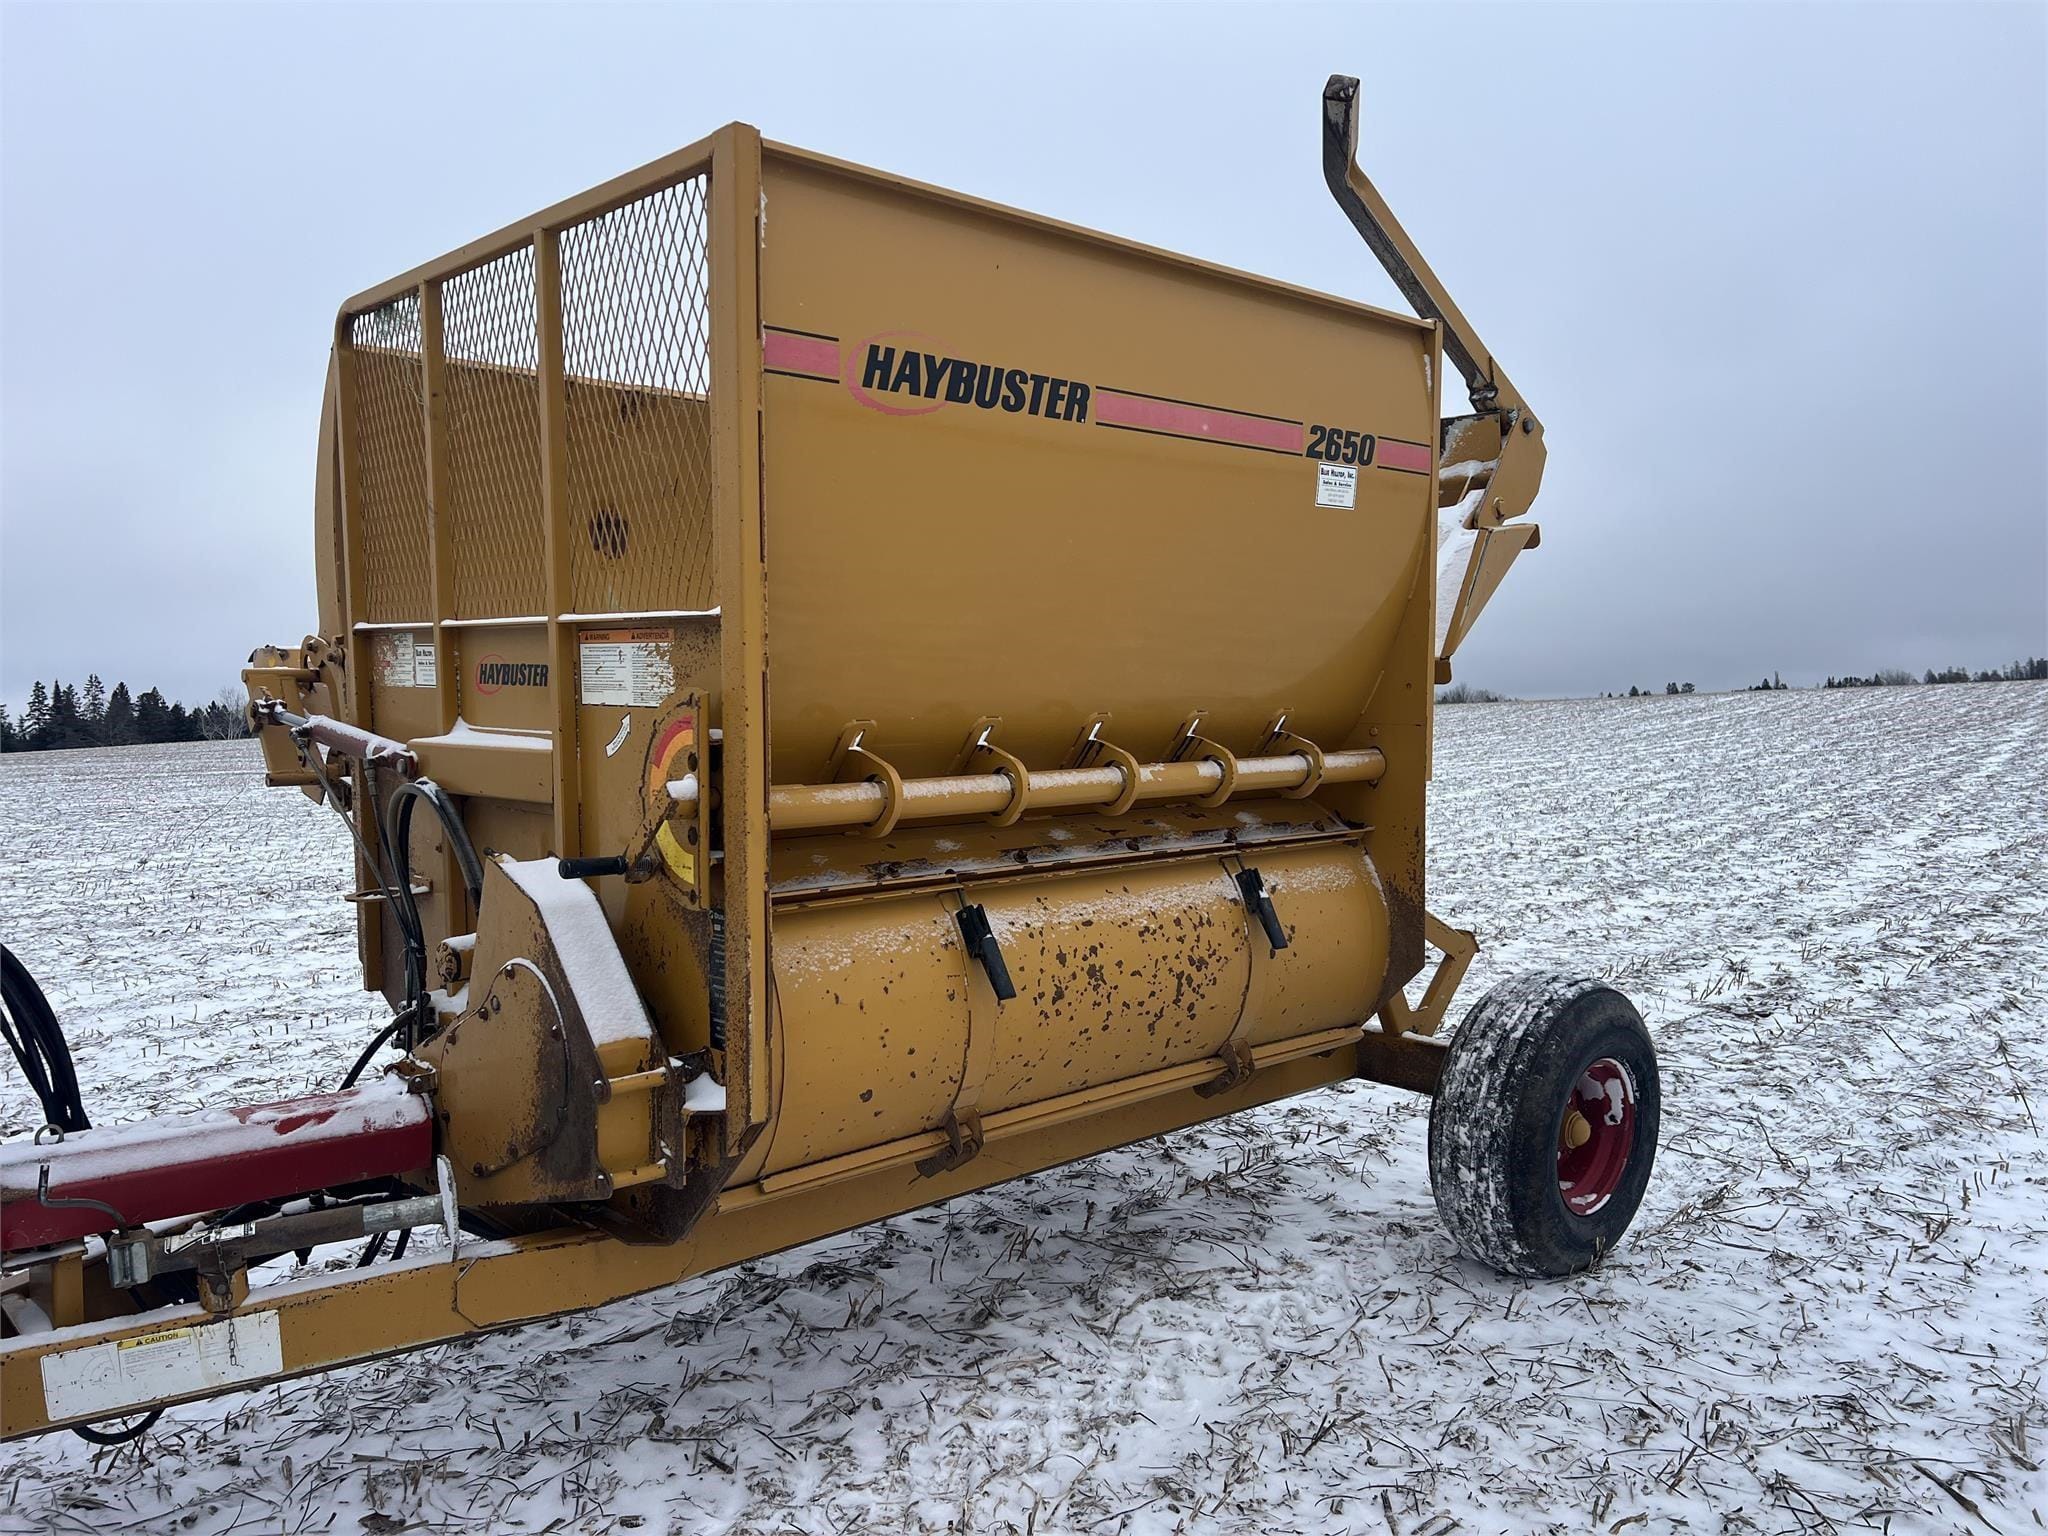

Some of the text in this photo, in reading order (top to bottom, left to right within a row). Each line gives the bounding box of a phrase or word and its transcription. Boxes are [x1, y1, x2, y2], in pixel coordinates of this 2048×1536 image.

[862, 344, 1090, 423] HAYBUSTER
[1306, 425, 1376, 466] 2650
[589, 633, 610, 641] WARNING
[636, 632, 670, 640] ADVERTENCIA
[479, 663, 549, 687] HAYBUSTER
[145, 1332, 179, 1344] CAUTION
